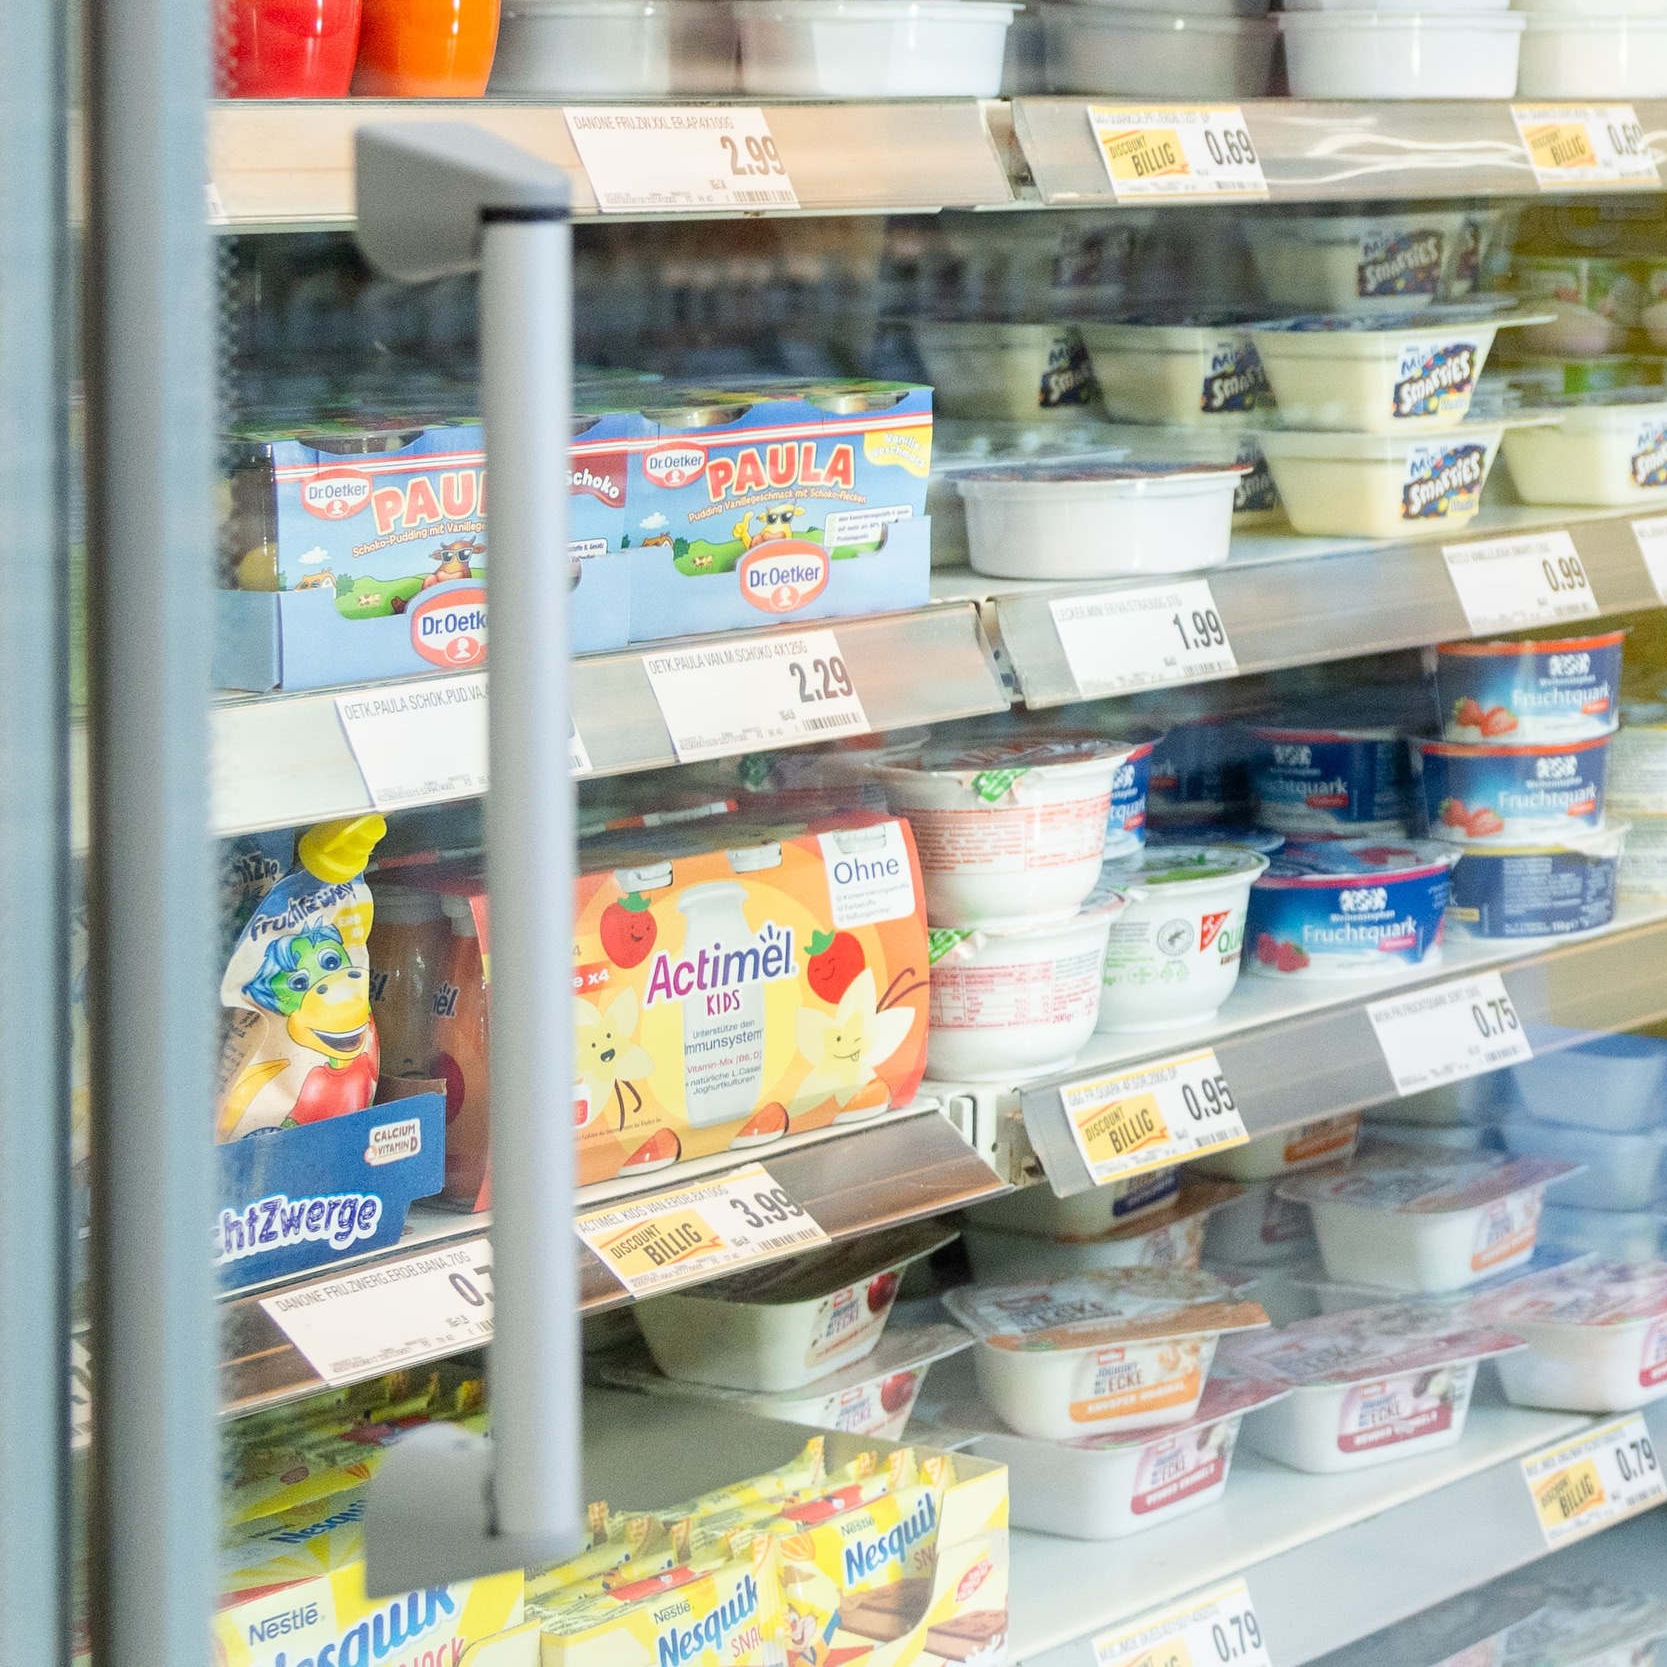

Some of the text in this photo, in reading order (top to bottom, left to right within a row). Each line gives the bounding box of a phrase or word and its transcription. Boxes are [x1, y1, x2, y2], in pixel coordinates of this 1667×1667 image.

[720, 135, 787, 176] 2.99
[1108, 134, 1149, 160] DISCOUNT
[1131, 141, 1177, 178] BILLIG
[1204, 129, 1257, 166] 0.69
[1549, 133, 1587, 167] BILLIG
[649, 453, 704, 471] Dr.Oetker
[706, 442, 855, 503] PAULA
[308, 483, 368, 501] Dr.Oetker
[687, 486, 868, 524] Pudding Vanillegeschmack mit Schoko-Flecken
[351, 522, 445, 559] Schoko-Pudding mit
[749, 564, 821, 588] Dr.Oetker
[1541, 556, 1586, 592] 0.99
[1172, 609, 1225, 651] 1.99
[789, 655, 853, 705] 2.29
[833, 858, 900, 886] Ohne
[1304, 917, 1417, 945] Fruchtquark
[587, 968, 610, 986] x4
[645, 923, 793, 1006] Actimel
[706, 989, 741, 1018] KIDS
[1471, 997, 1518, 1039] 0.75
[692, 1022, 739, 1040] Unterstütze
[686, 1056, 734, 1075] Vitamin-Mix
[690, 1072, 731, 1089] natürliche
[1181, 1075, 1236, 1122] 0.95
[374, 1123, 416, 1144] CALCIUM
[1085, 1105, 1125, 1142] DISCOUNT
[1109, 1108, 1155, 1155] BILLIG
[377, 1140, 410, 1156] VITAMIN
[578, 1215, 624, 1235] ACTIMEL
[623, 1205, 646, 1222] KIDS
[728, 1187, 805, 1229] 3.99
[609, 1224, 662, 1260] DISCOUNT
[641, 1222, 703, 1268] BILLIG
[1615, 1438, 1658, 1486] 0.79
[1560, 1474, 1596, 1520] BILLIG
[1210, 1610, 1263, 1664] 0.79
